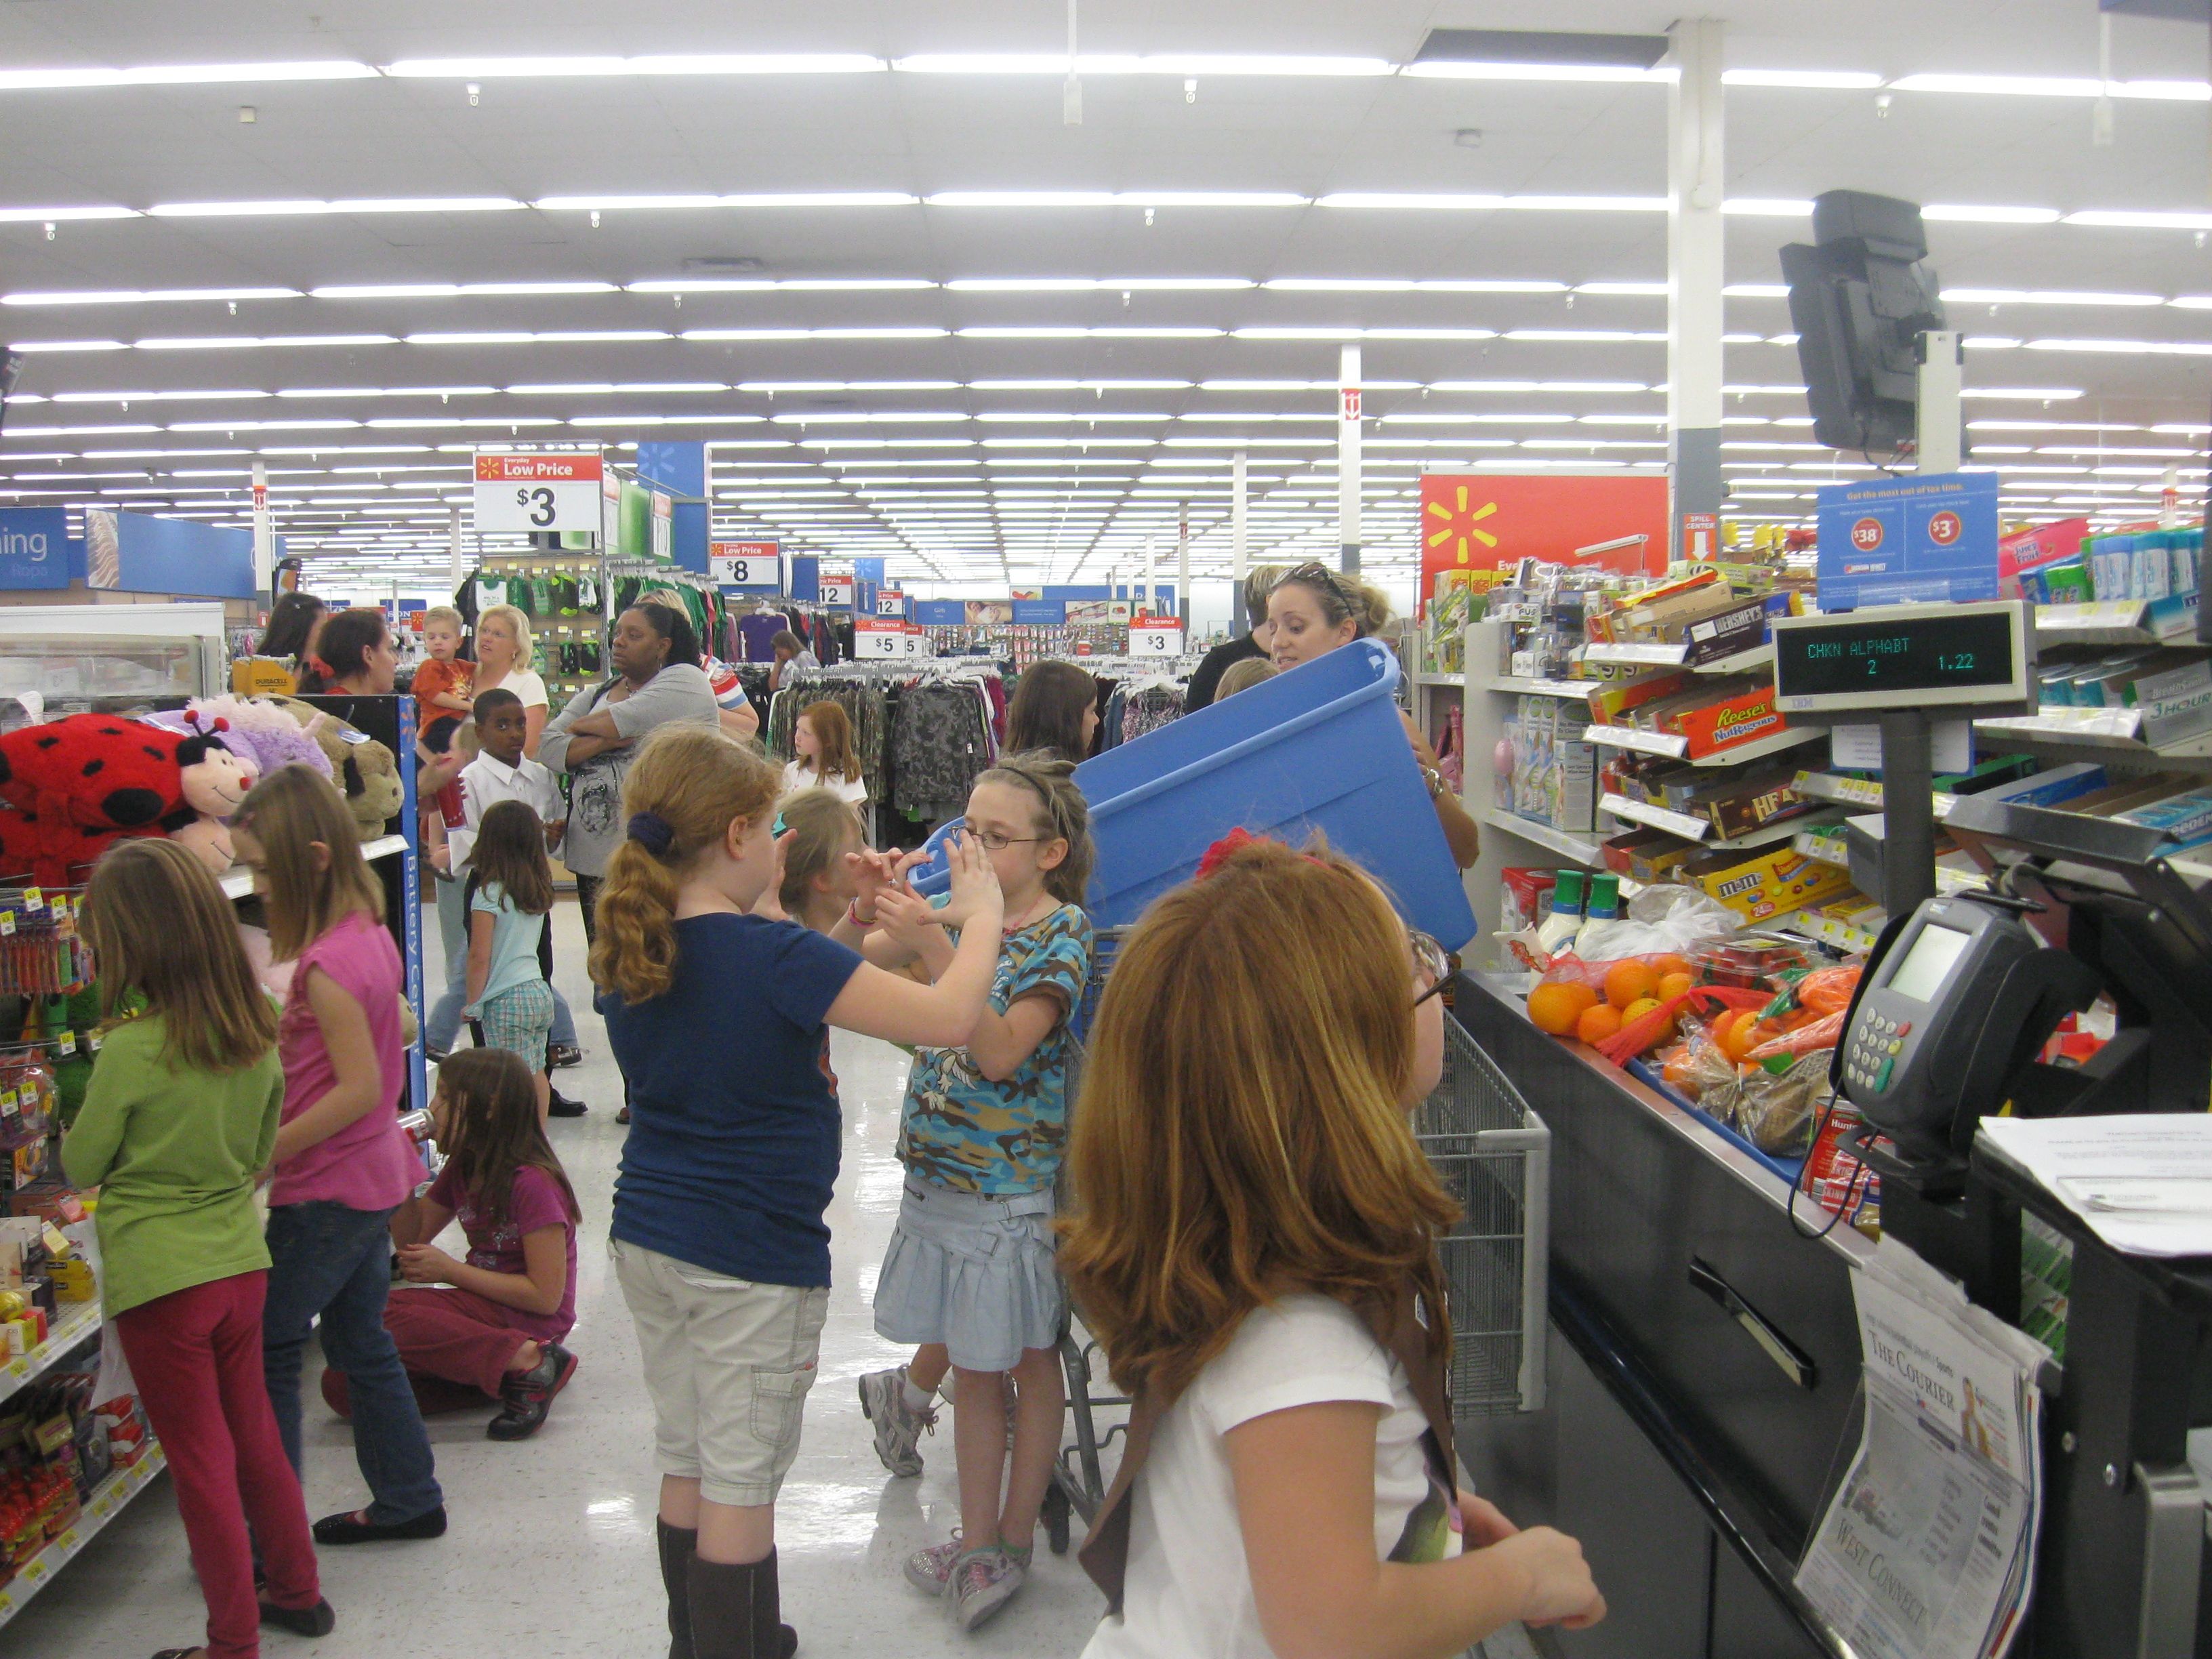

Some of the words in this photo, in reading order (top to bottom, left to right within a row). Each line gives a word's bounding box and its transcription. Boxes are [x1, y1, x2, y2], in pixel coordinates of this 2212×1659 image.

[504, 464, 533, 476] Low
[536, 463, 573, 476] Price
[516, 487, 556, 527] $3
[1853, 529, 1878, 543] $38
[1932, 520, 1950, 537] $3
[0, 527, 47, 562] ing
[724, 546, 741, 554] Low
[741, 546, 762, 554] Price
[726, 560, 749, 581] $8
[1715, 605, 1763, 634] HERSHEY'S
[876, 638, 894, 652] $5
[1147, 636, 1165, 650] $3
[1806, 643, 1841, 659] CHKN
[1849, 638, 1910, 656] ALPHABT
[1867, 659, 1877, 674] 2
[1938, 653, 1974, 671] 1.22
[1791, 698, 1814, 709] IBM
[2150, 701, 2163, 718] 3
[1717, 702, 1767, 729] Reese's
[1713, 715, 1778, 743] NutRageous
[1751, 787, 1801, 823] HEA
[1868, 1329, 1895, 1367] THE
[1897, 1351, 1956, 1412] COURIER
[1836, 1517, 1870, 1569] WEST
[1868, 1552, 1928, 1628] CONNECT
